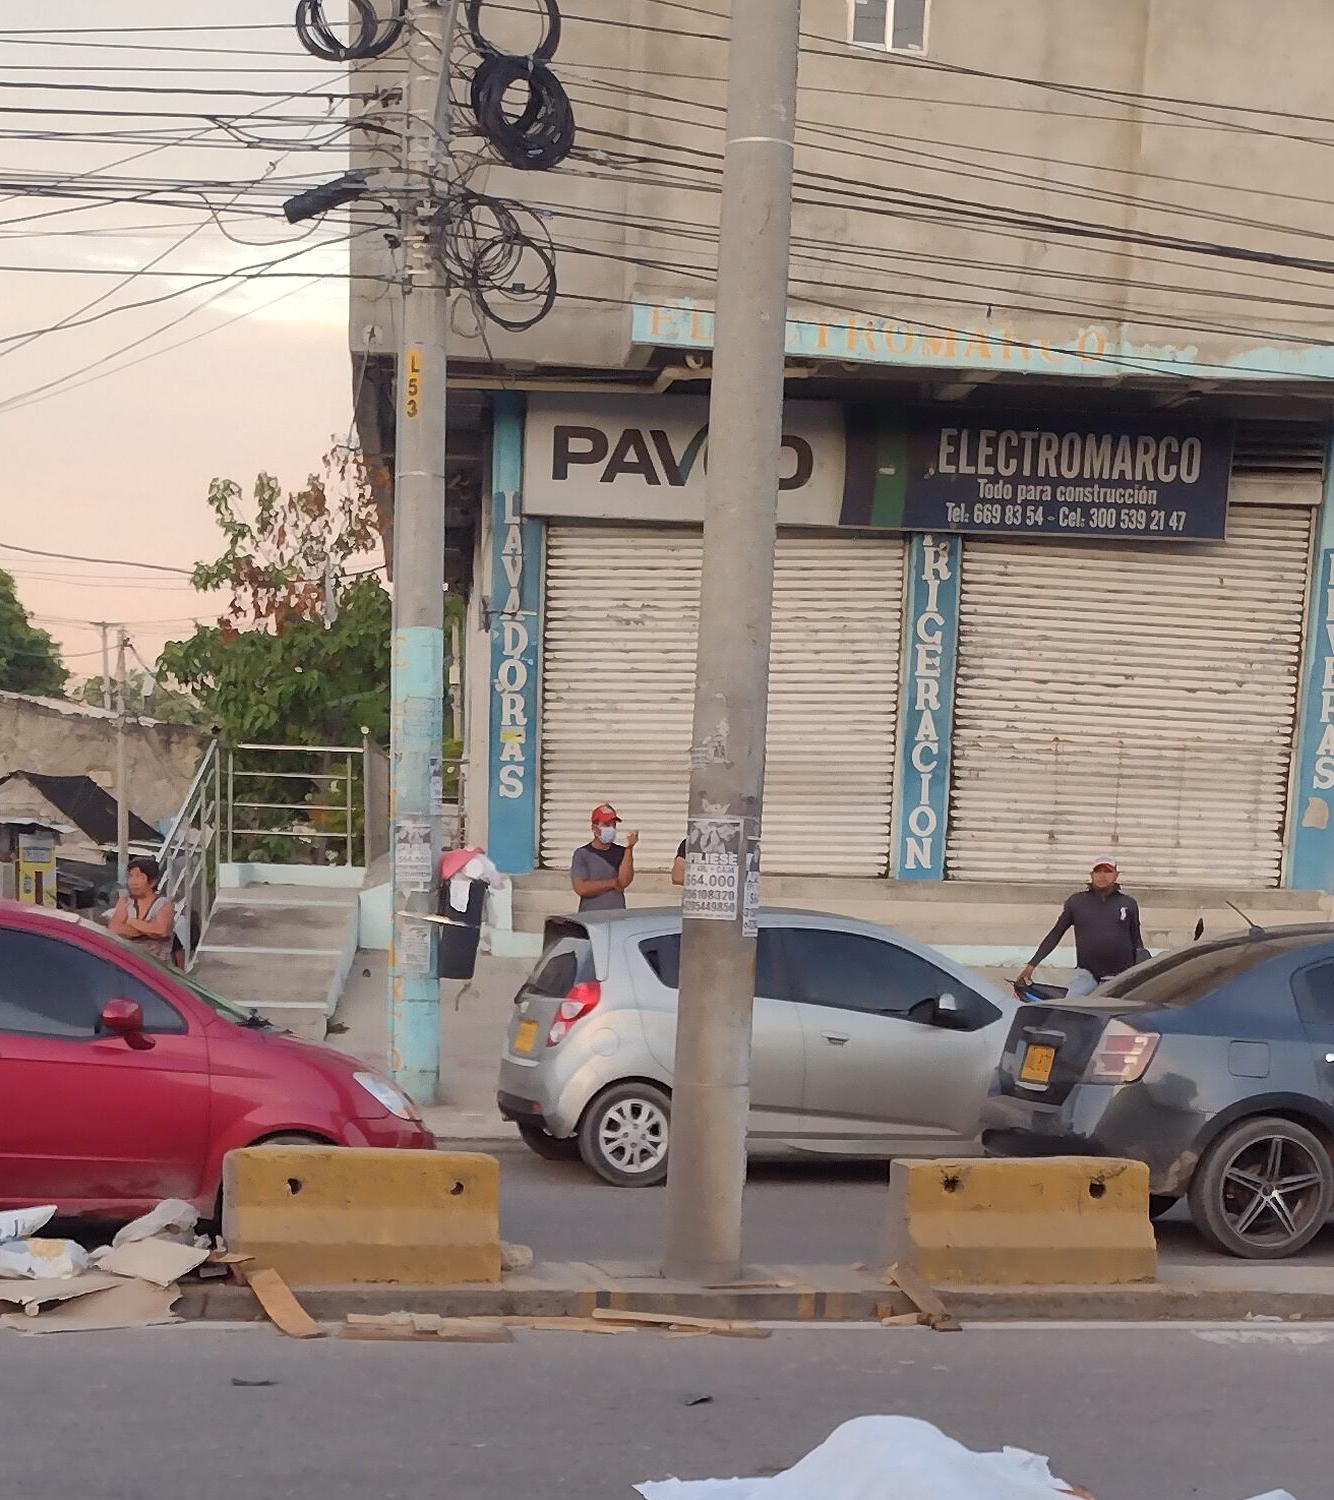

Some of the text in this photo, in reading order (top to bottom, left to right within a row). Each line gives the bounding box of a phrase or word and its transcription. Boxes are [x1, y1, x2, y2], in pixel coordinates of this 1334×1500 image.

[552, 425, 814, 491] PAVO
[938, 427, 1202, 484] ELECTROMARCO
[945, 502, 969, 523] Tel:
[973, 503, 1000, 525] 669
[1004, 505, 1022, 525] 83
[1026, 506, 1044, 526] 54
[1059, 507, 1085, 527] Cel:
[1089, 508, 1116, 529] 300
[1120, 510, 1146, 530] 539
[1149, 511, 1165, 531] 21
[1168, 511, 1187, 532] 47
[977, 478, 1157, 505] Todo para construcción
[496, 489, 530, 799] LAVADORAS
